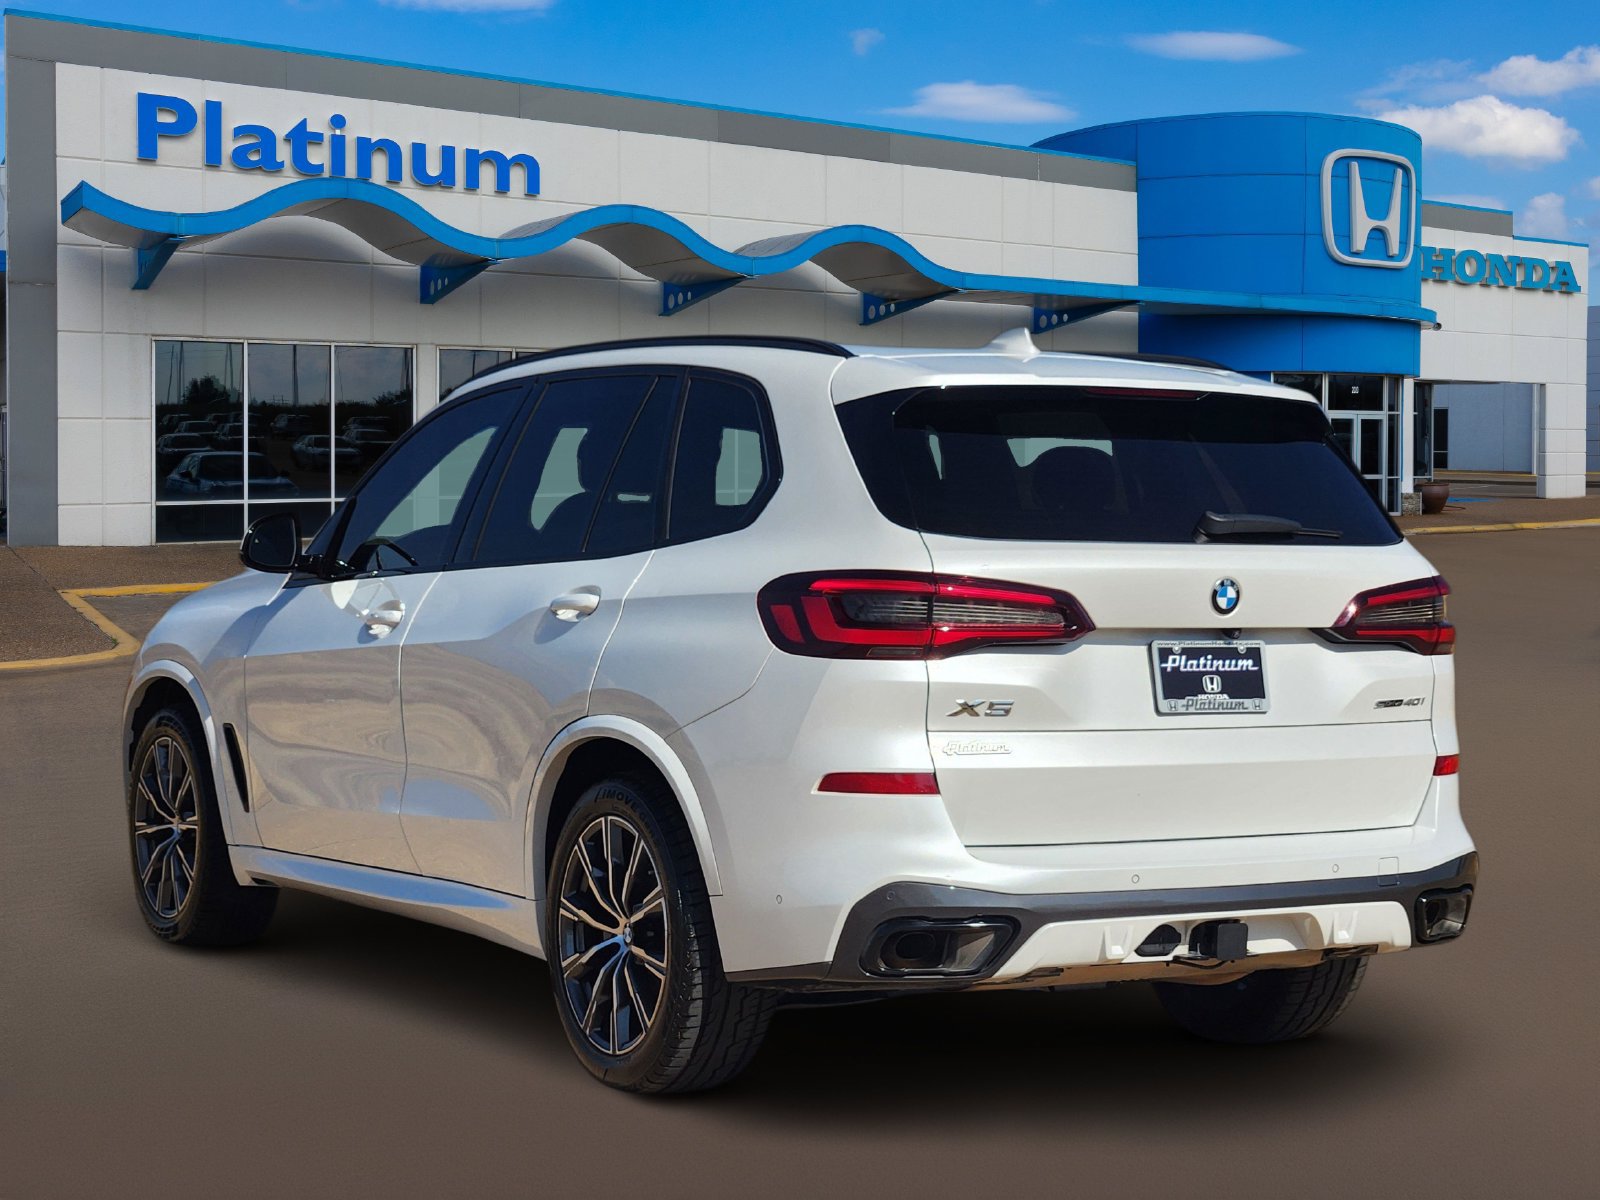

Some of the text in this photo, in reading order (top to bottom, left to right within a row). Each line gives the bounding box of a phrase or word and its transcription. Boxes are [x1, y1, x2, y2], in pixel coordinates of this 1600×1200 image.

[137, 91, 541, 197] Platinum
[1421, 246, 1582, 293] HONDA
[1160, 655, 1260, 672] Platinum
[945, 699, 1015, 717] X5
[1181, 697, 1249, 711] Platinum
